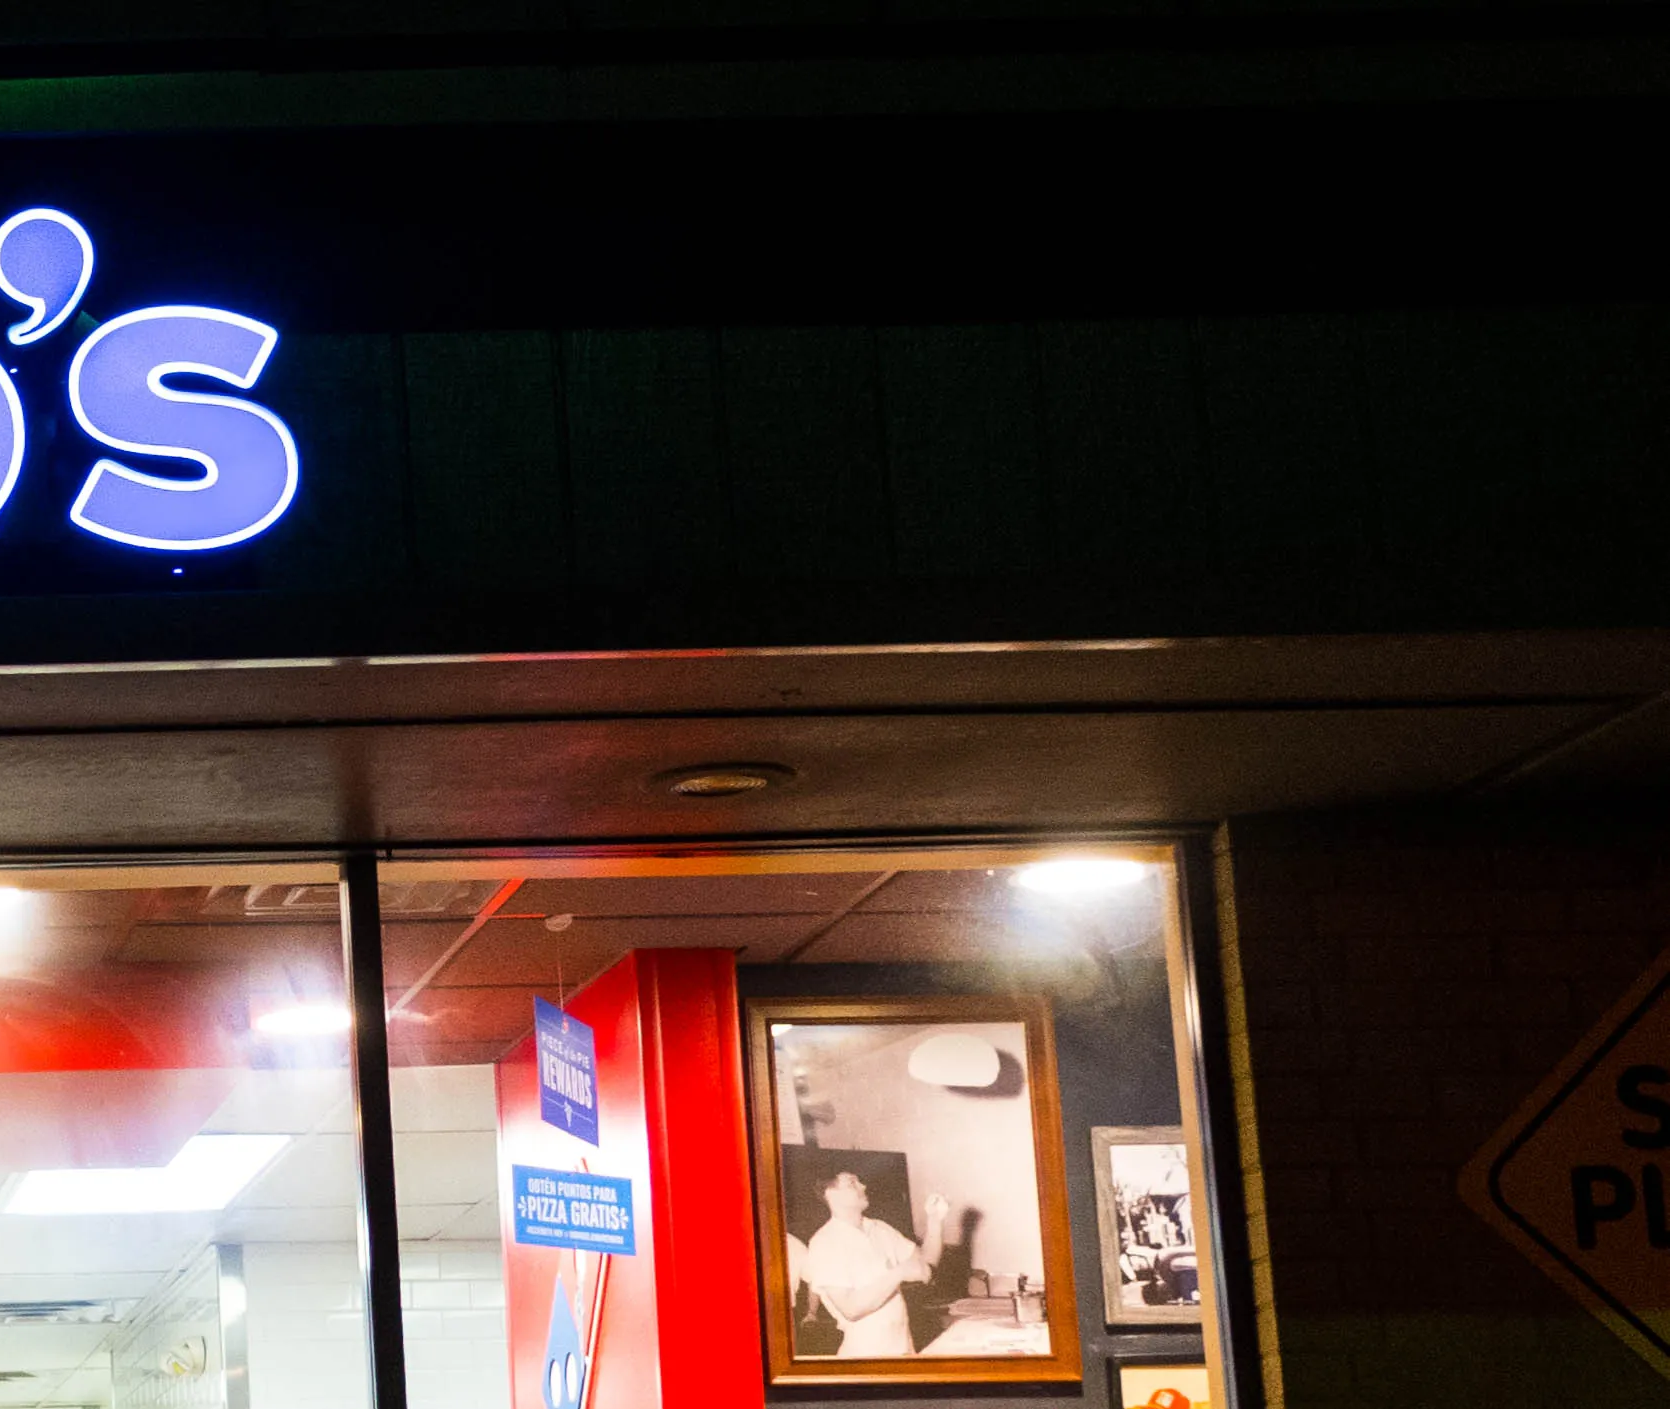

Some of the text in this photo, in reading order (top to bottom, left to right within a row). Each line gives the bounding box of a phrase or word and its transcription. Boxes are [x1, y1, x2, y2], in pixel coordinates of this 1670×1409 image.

[541, 1049, 593, 1110] REWARDS
[593, 1186, 617, 1203] PARA
[527, 1195, 620, 1231] PIZZA GRATIS
